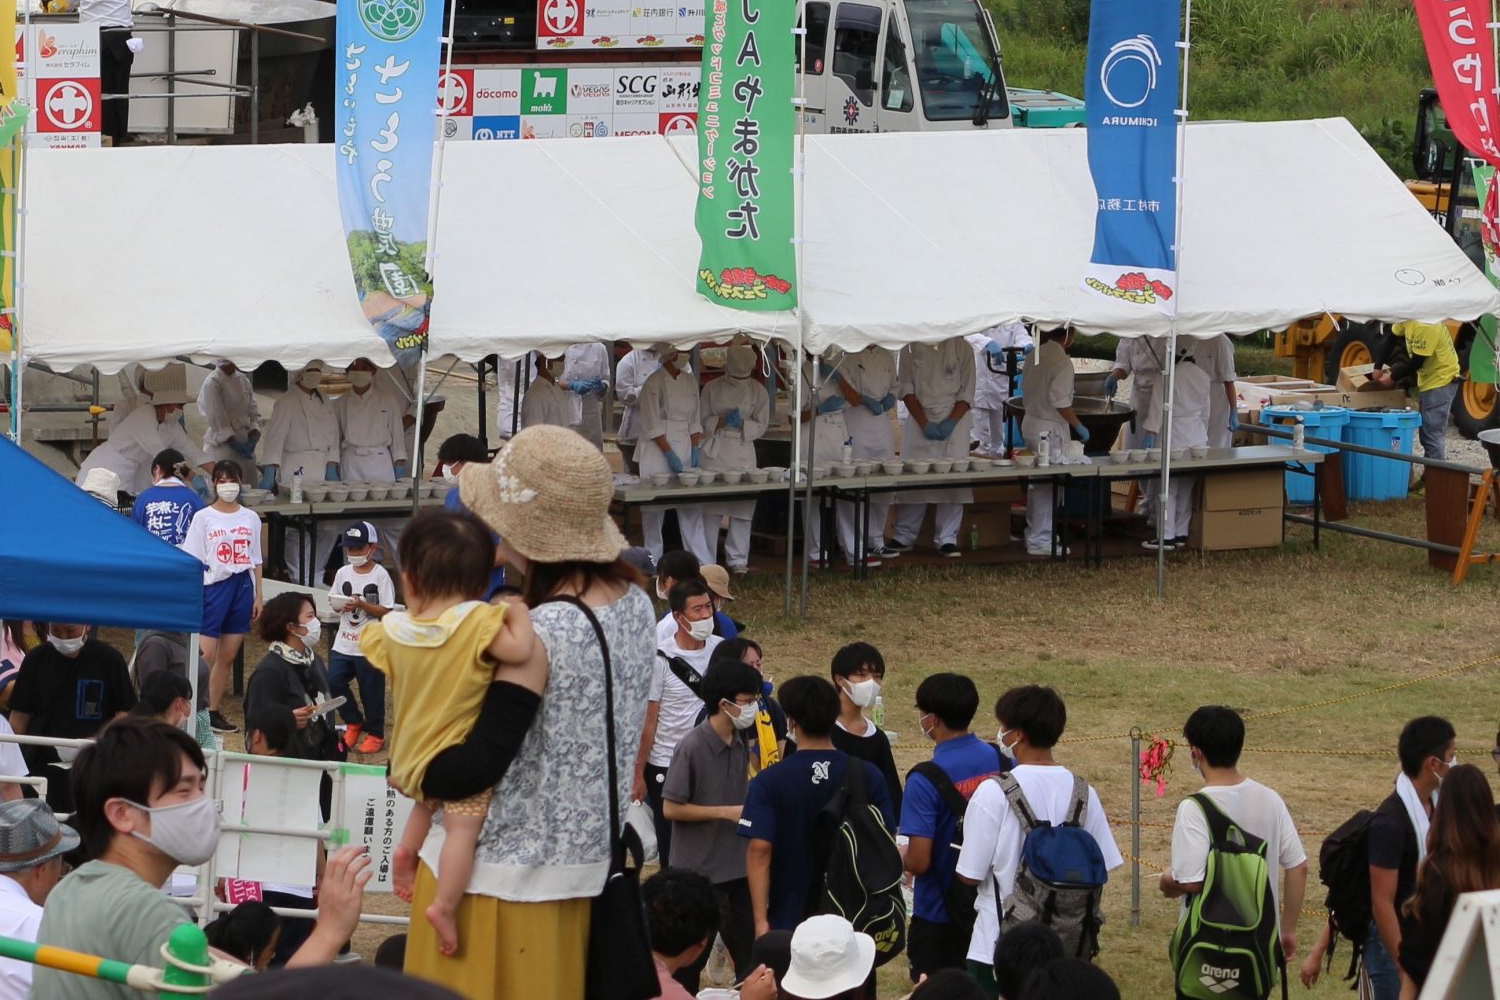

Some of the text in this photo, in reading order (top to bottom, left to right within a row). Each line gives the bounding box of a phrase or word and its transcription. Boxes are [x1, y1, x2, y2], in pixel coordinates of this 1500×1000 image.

[643, 7, 674, 17] 荘内銀行
[616, 74, 657, 94] SCG
[476, 88, 518, 99] docomo
[496, 129, 516, 138] NTT
[145, 500, 179, 517] 芋煮と
[147, 516, 172, 530] 共に
[208, 528, 228, 541] 34th
[362, 797, 376, 860] ご遠慮願いま
[1201, 963, 1240, 979] arena
